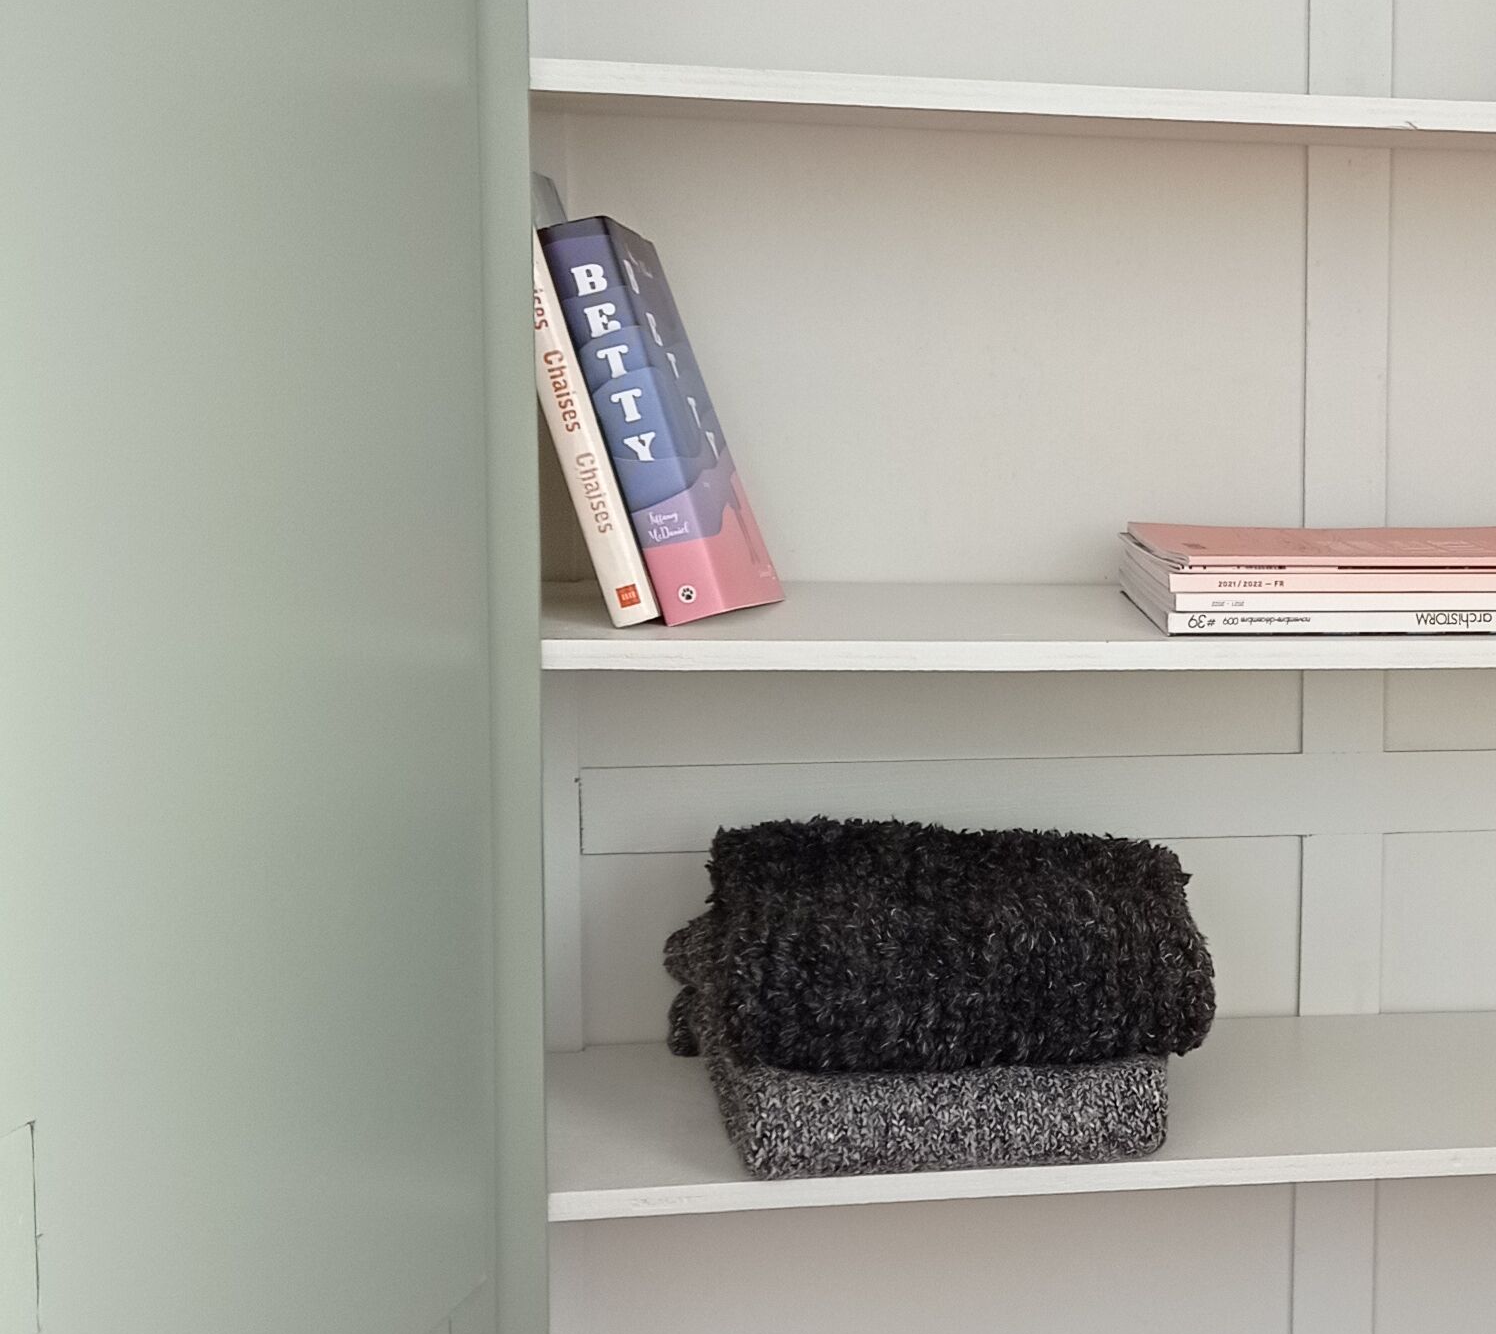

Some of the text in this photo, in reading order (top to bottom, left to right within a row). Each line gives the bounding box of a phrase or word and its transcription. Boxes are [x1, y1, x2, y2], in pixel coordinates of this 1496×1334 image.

[571, 264, 656, 461] BETTY
[543, 349, 581, 433] Chaises
[575, 452, 613, 534] Chaises
[1274, 580, 1285, 588] FR
[1187, 614, 1216, 629] #39
[1415, 612, 1493, 628] archiSTORM
